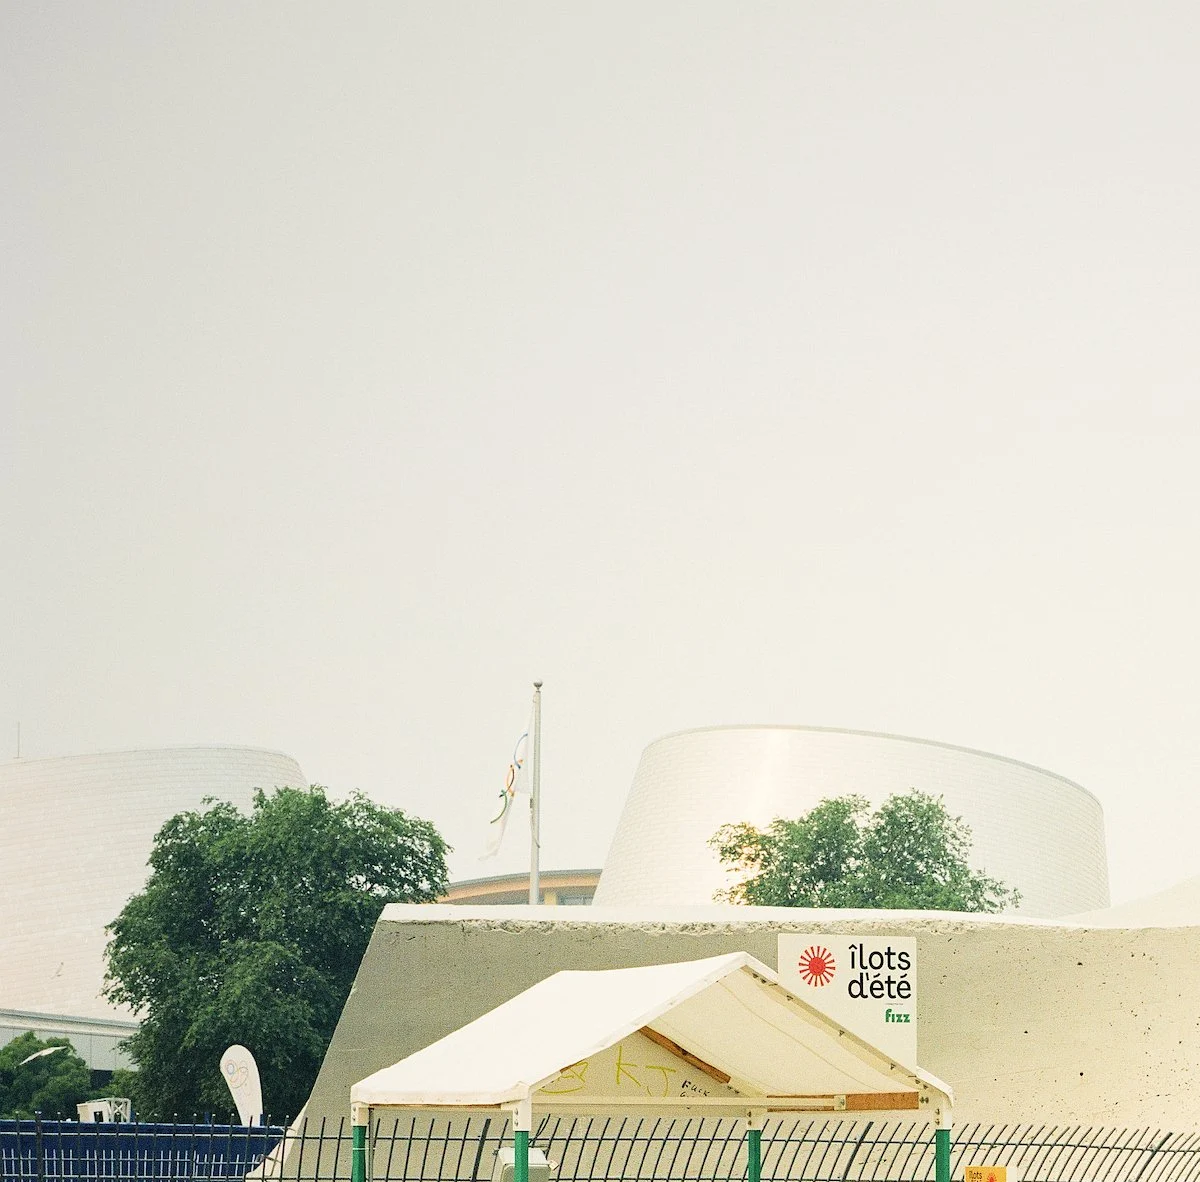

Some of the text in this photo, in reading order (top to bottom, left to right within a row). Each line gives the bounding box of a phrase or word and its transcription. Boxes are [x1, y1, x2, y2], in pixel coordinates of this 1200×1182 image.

[848, 943, 911, 970] îlots
[847, 972, 911, 999] d'été
[885, 1008, 910, 1023] fizz
